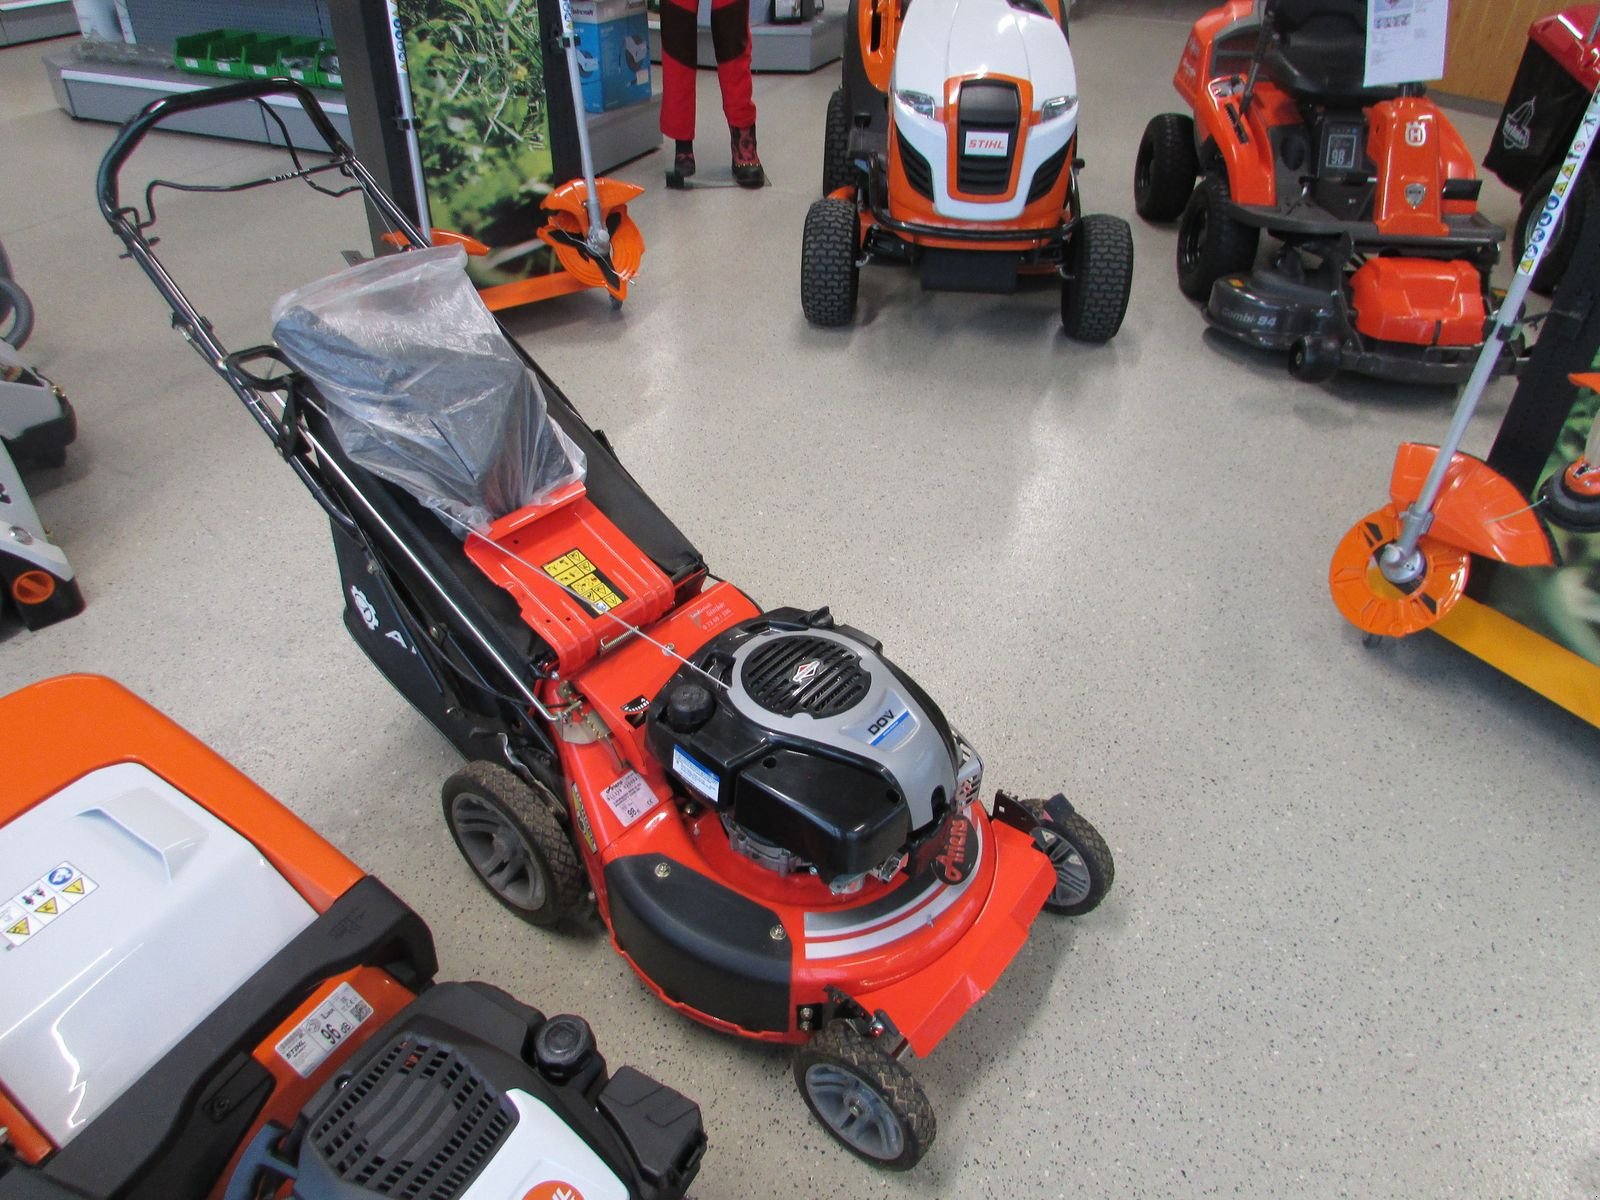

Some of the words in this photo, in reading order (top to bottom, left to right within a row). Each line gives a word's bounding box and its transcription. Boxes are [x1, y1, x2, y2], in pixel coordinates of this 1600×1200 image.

[969, 139, 1006, 149] STIHL
[1331, 150, 1345, 164] 98
[1257, 315, 1277, 327] 94
[868, 709, 895, 736] DOV
[627, 807, 638, 818] 98
[936, 819, 968, 881] Ariens
[321, 1024, 341, 1044] 96
[341, 1022, 352, 1033] dB
[286, 1040, 306, 1059] STIHL
